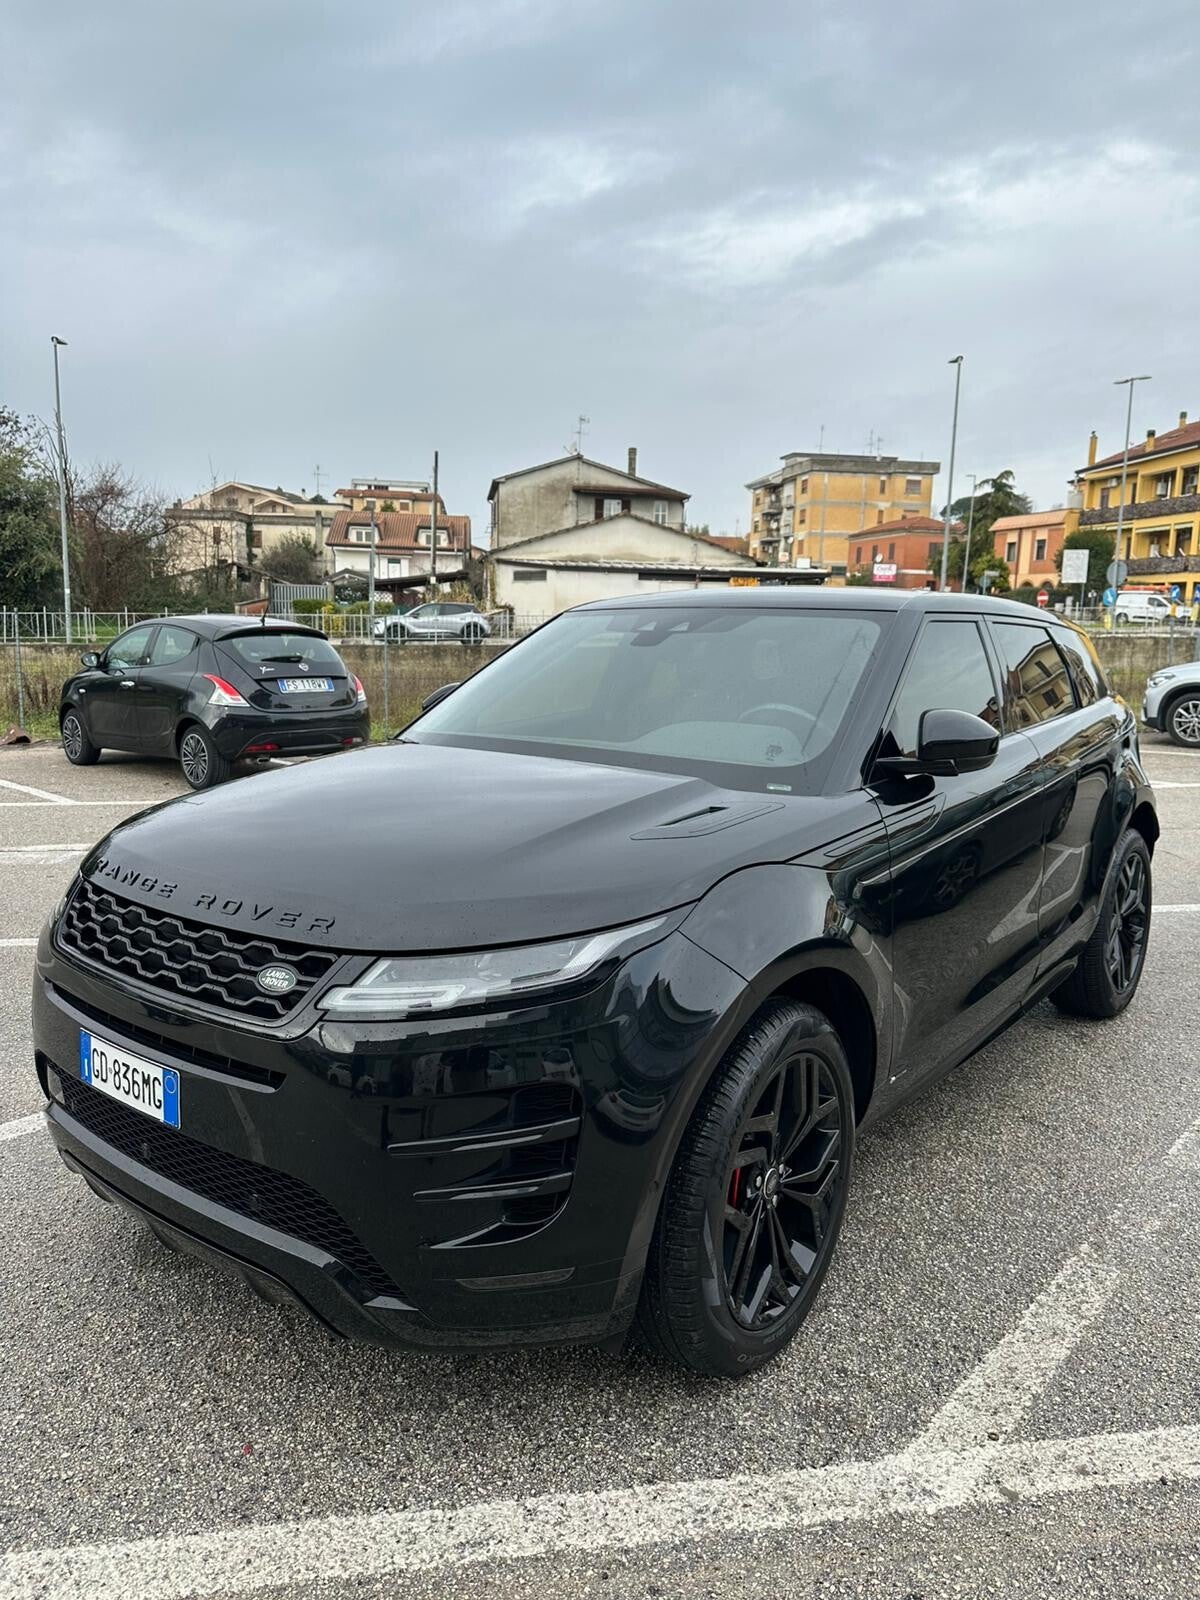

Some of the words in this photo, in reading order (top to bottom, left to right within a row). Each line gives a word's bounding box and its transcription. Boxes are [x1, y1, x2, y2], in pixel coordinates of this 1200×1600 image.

[286, 680, 299, 690] FS
[97, 858, 179, 899] RANGE
[193, 894, 336, 935] ROVER
